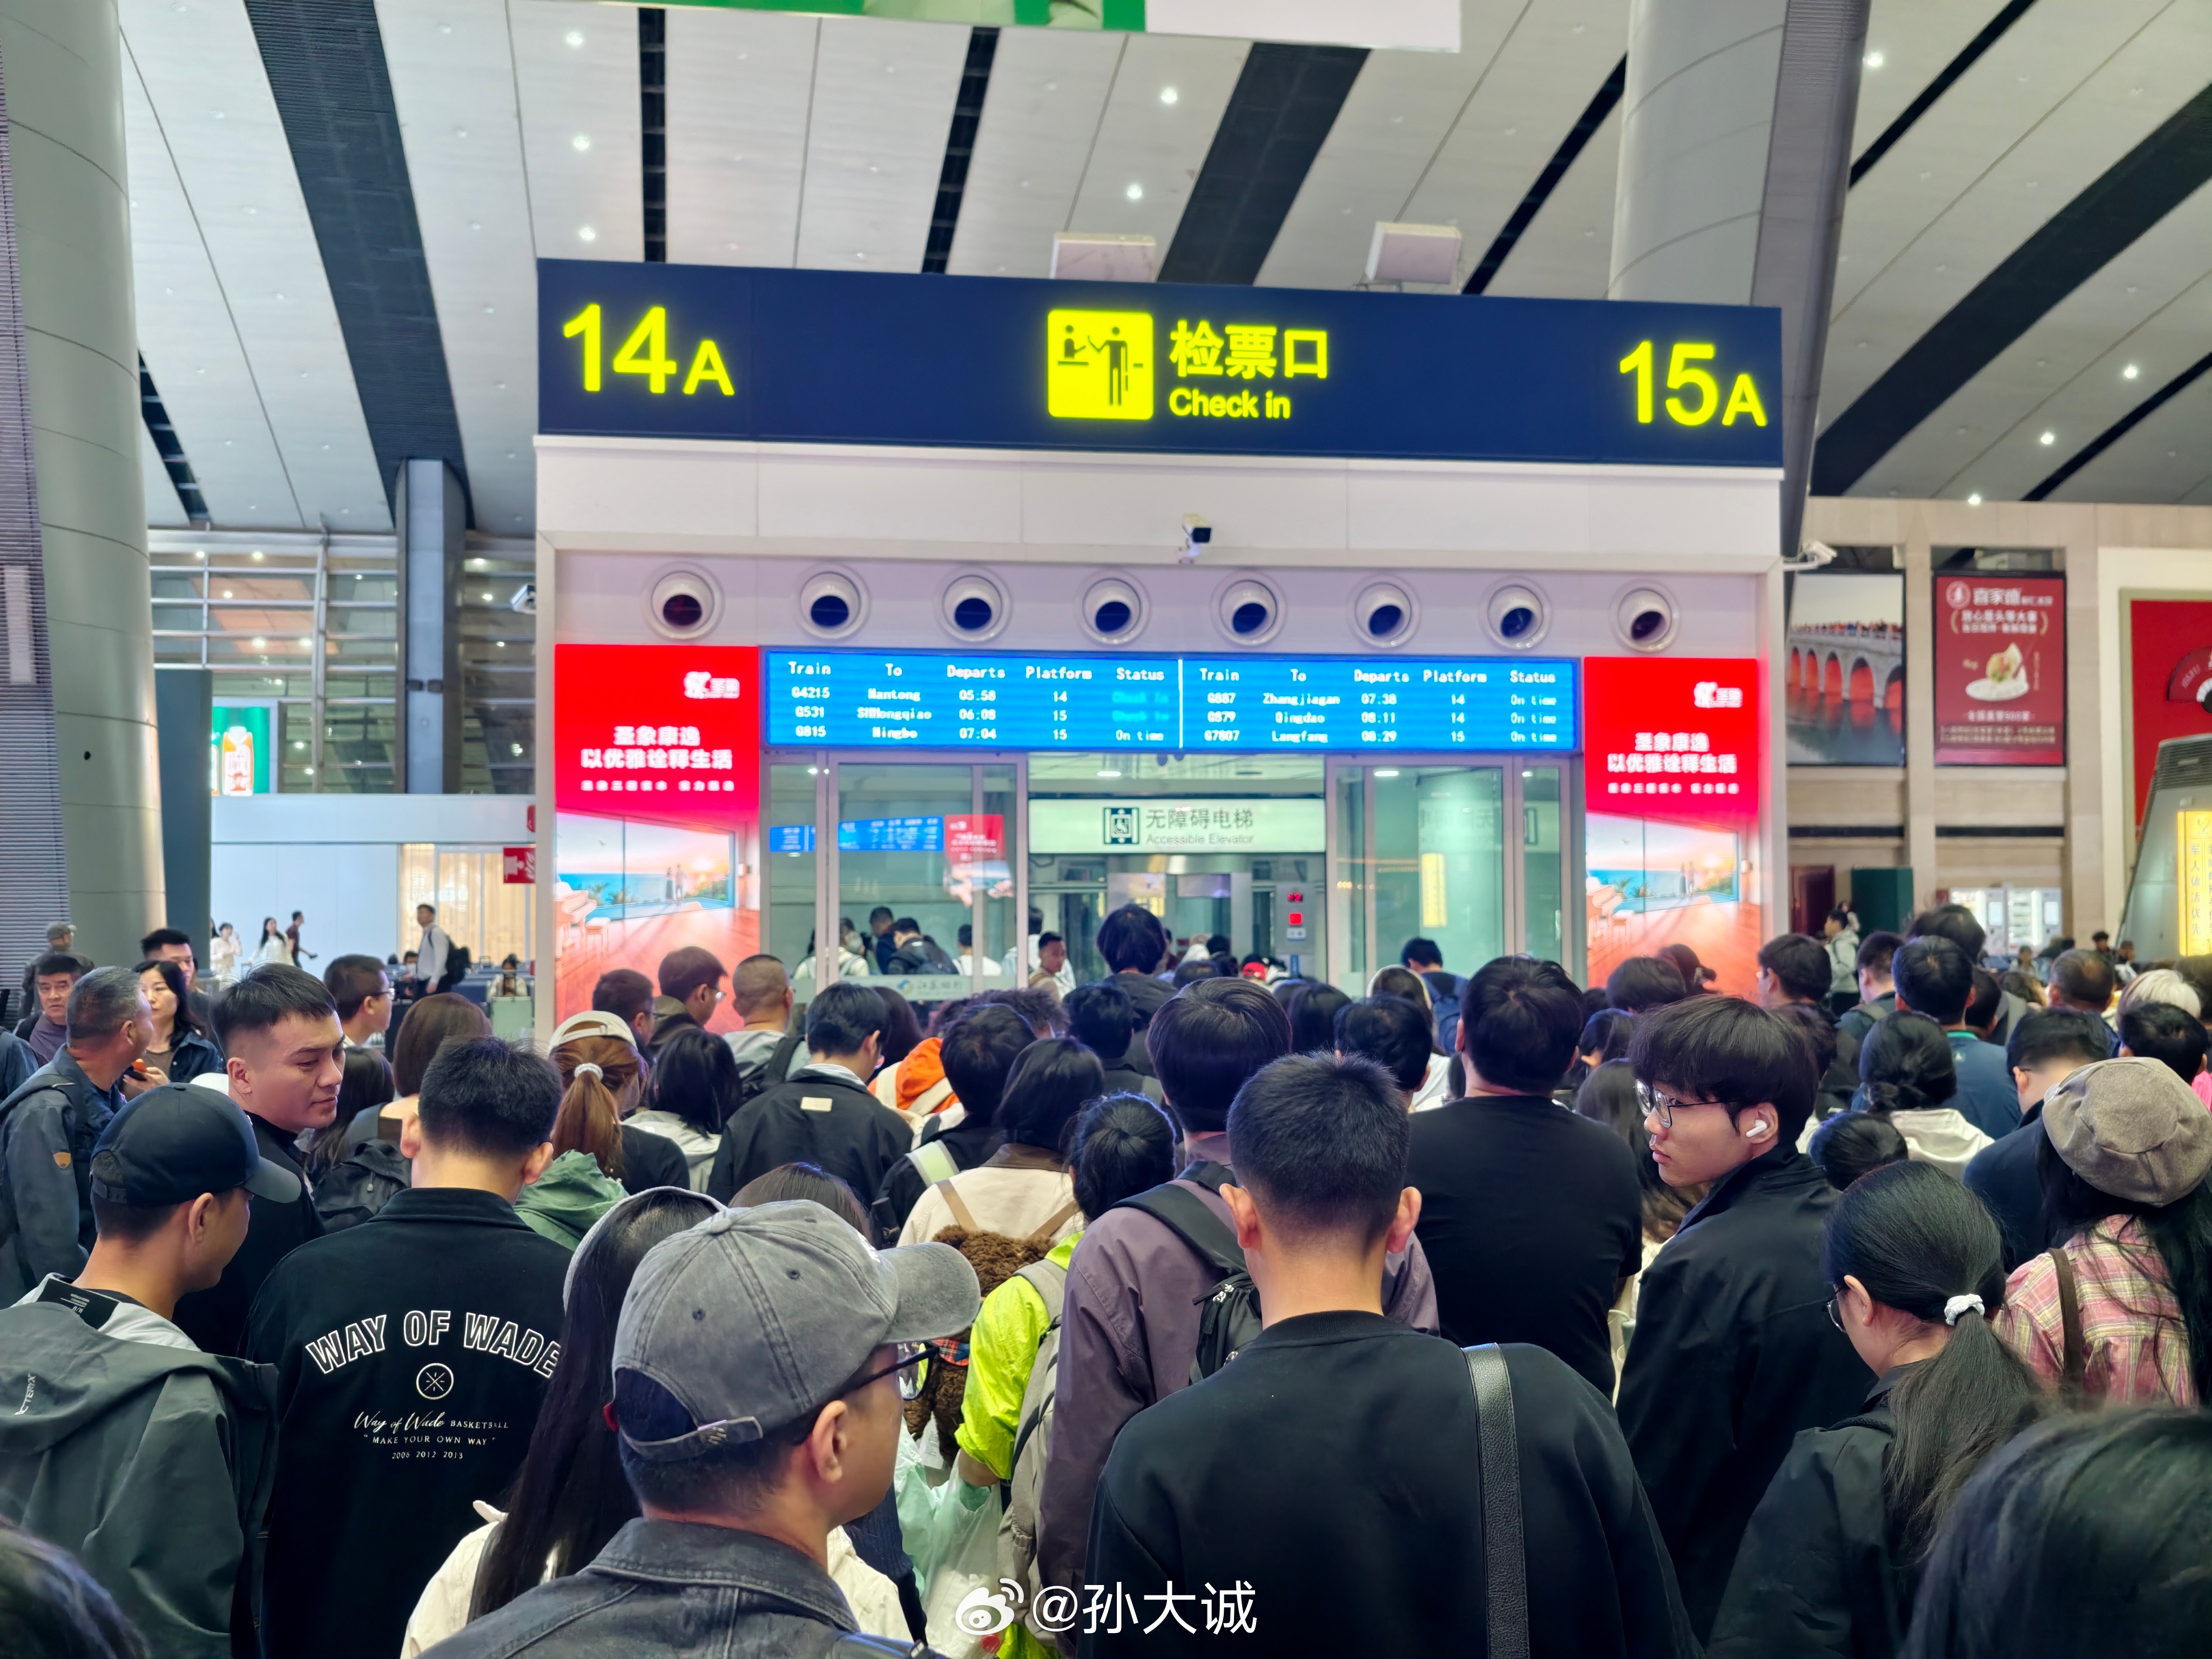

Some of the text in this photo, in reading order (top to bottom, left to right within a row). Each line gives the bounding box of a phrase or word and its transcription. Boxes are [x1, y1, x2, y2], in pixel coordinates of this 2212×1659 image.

[563, 304, 734, 396] 14A
[1169, 320, 1329, 379] 检票口
[1620, 340, 1768, 427] 15A
[1169, 388, 1290, 420] Check in
[788, 661, 1164, 680] Train To Departs Platform Status
[1199, 667, 1556, 684] Train To Departs Platform Status
[868, 687, 921, 702] Nantong
[959, 689, 996, 702] 05:58
[1054, 691, 1068, 702] 14
[1361, 693, 1397, 705] 07:38
[1451, 694, 1465, 705] 14
[1510, 694, 1525, 705] On
[1531, 696, 1556, 705] time
[795, 705, 825, 718] G531
[959, 708, 996, 720] 06:08
[1054, 710, 1068, 721] 15
[1275, 711, 1325, 724] Qingdao
[1361, 711, 1395, 723] 08:11
[1451, 712, 1465, 723] 14
[1511, 712, 1525, 724] On
[1531, 714, 1556, 724] time
[872, 726, 918, 739] Ningbo
[959, 727, 997, 739] 07:04
[1054, 729, 1068, 740] 15
[1116, 730, 1131, 740] On
[1137, 732, 1164, 741] time
[1272, 730, 1328, 743] Langfang
[1451, 731, 1465, 742] 15
[1510, 731, 1525, 741] On
[1531, 733, 1557, 742] time
[581, 748, 733, 770] 以优雅诠释生活
[1607, 753, 1737, 774] 以优雅诠释生活
[1146, 808, 1253, 829] 无障碍电梯
[1145, 833, 1254, 844] Accessible Elevator
[2190, 844, 2201, 935] 军人依法优先
[305, 1310, 562, 1379] WAY OF WADE
[354, 1411, 509, 1434] Way of Wade BASKETBALL
[372, 1435, 488, 1446] MAKE YOUR OWN WAY
[415, 1451, 436, 1459] 2012
[442, 1451, 463, 1459] 2013
